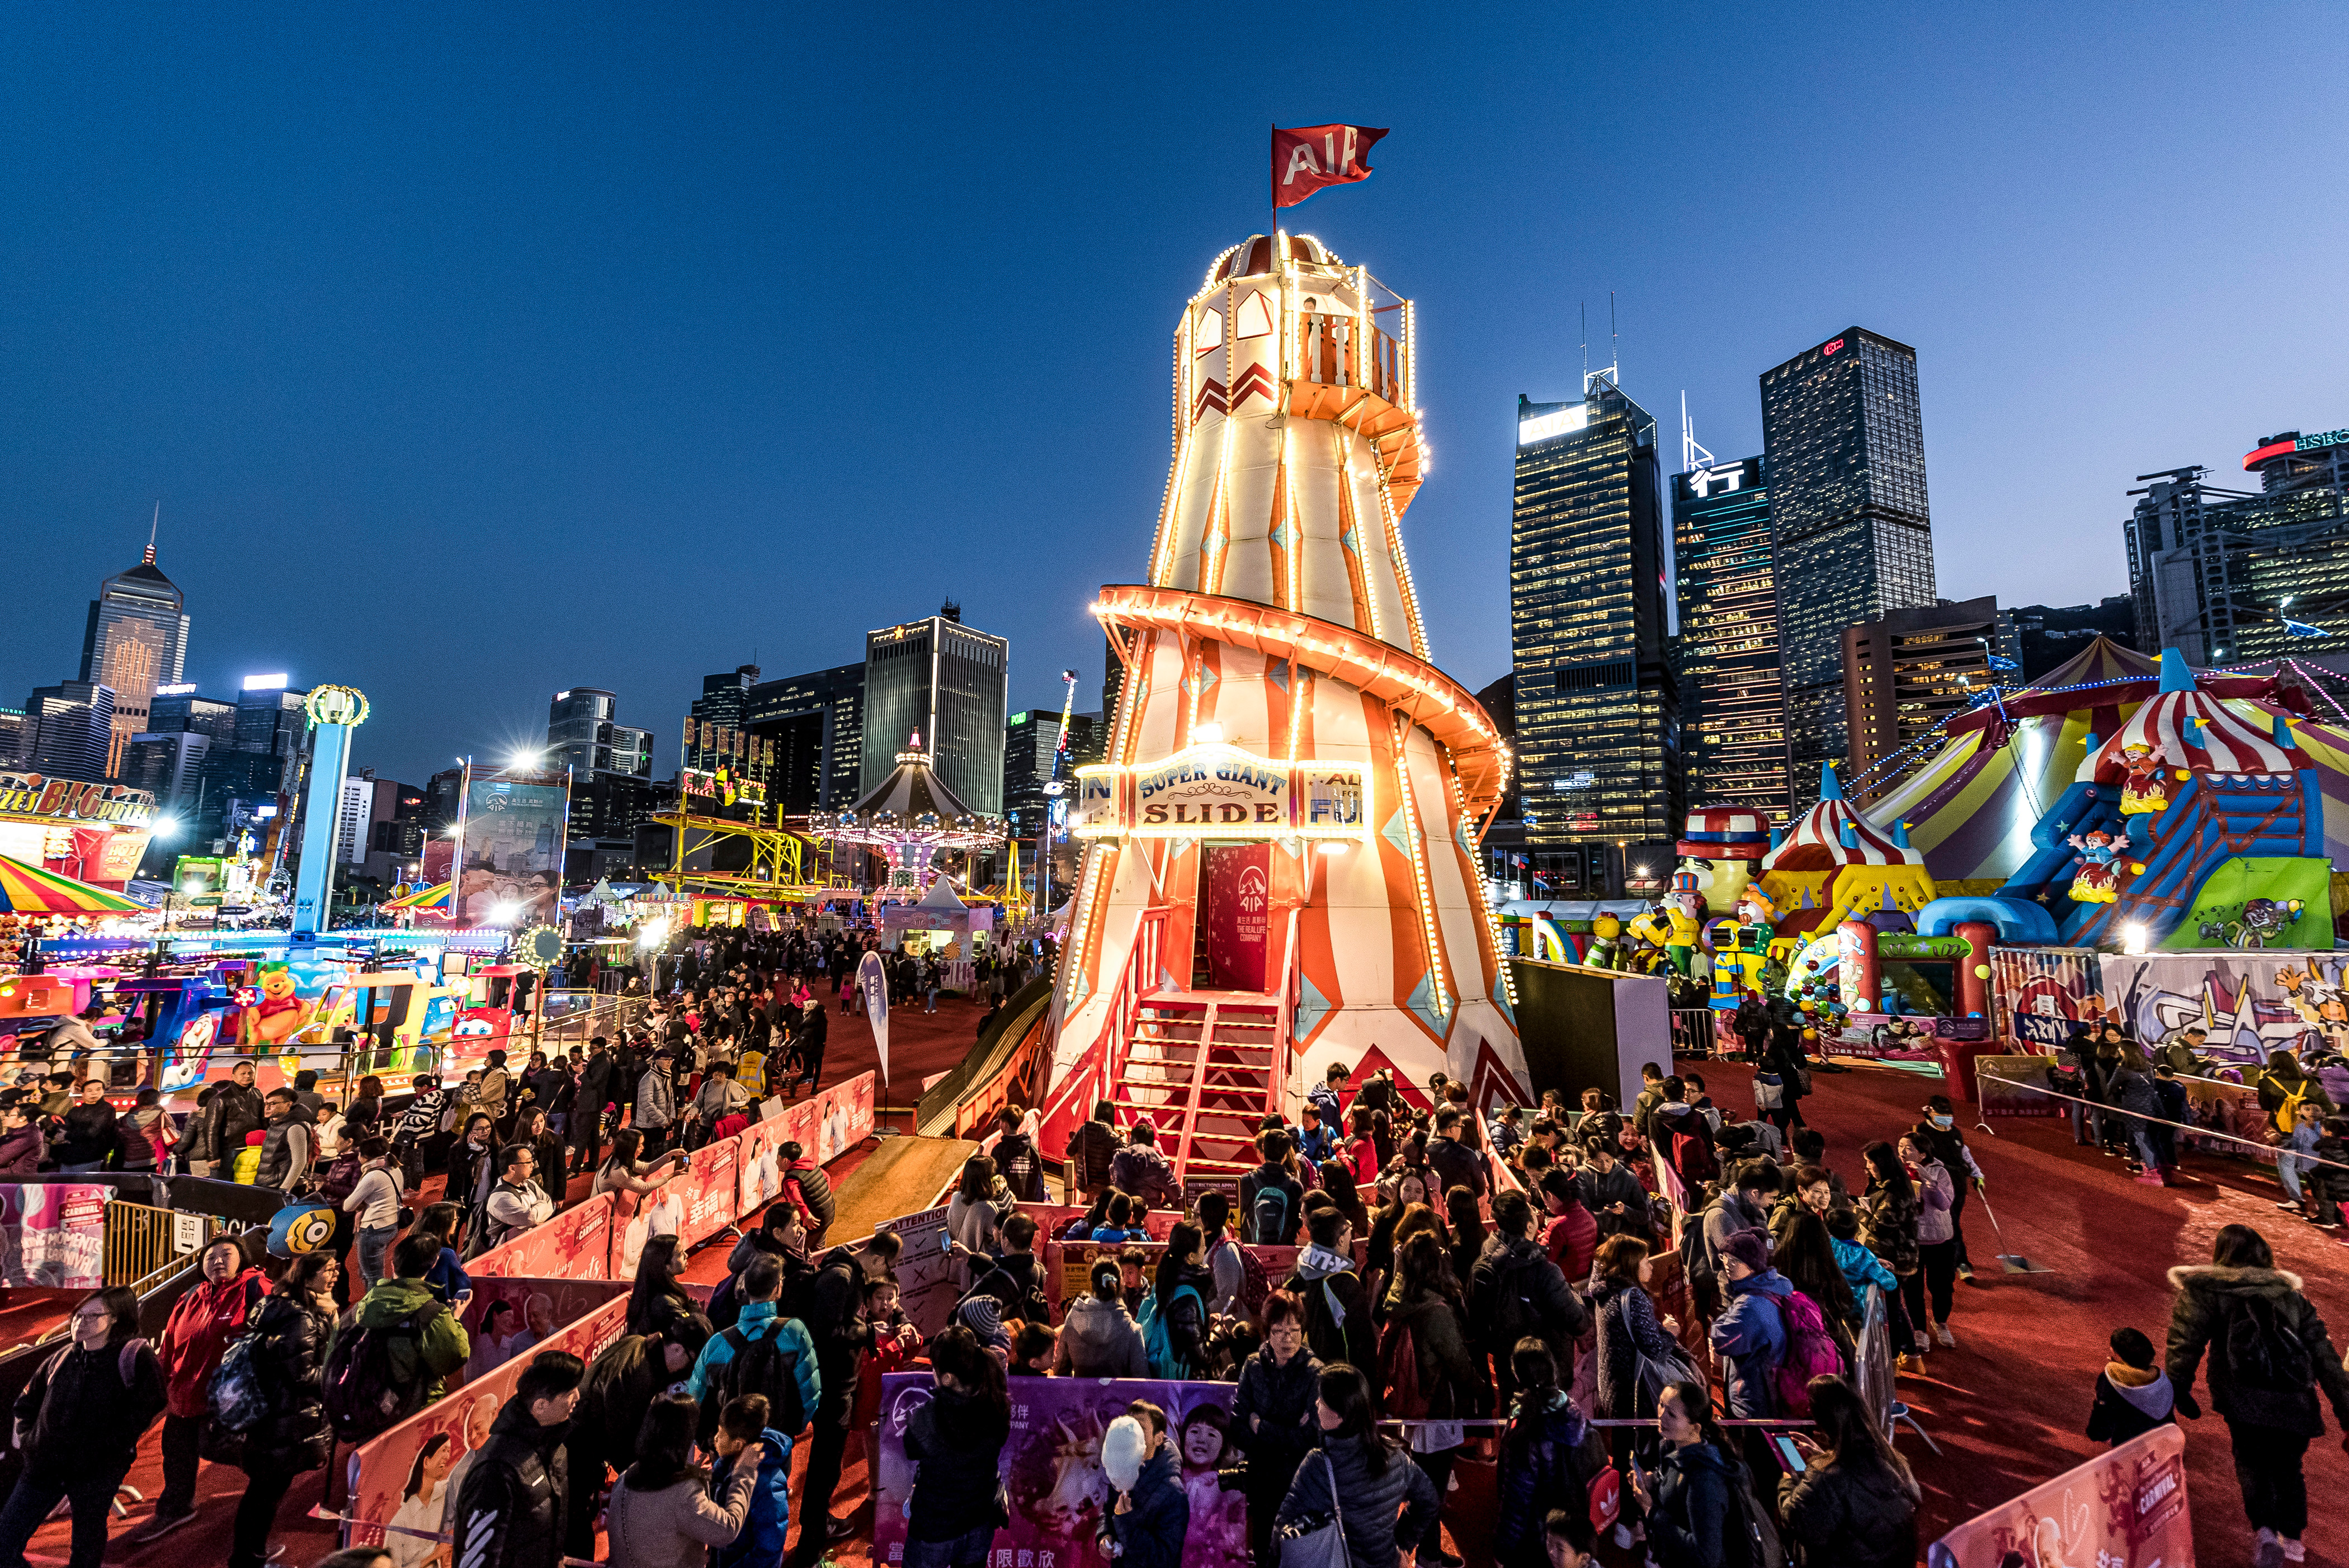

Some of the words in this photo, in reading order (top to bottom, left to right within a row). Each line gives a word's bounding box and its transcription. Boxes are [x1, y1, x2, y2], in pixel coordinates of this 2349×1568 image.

[1282, 125, 1357, 185] AIA
[1530, 413, 1576, 438] AIA
[1689, 461, 1744, 498] 行
[1139, 763, 1207, 800] SUPER
[1216, 762, 1287, 796] GIANT
[1325, 773, 1361, 786] AL
[0, 788, 39, 811] ZES
[35, 782, 103, 818] BIG
[1144, 802, 1279, 824] SLIDE
[108, 843, 144, 856] HOT
[1240, 896, 1263, 912] AIA
[689, 1189, 719, 1226] 幸福
[181, 1231, 195, 1240] EXIT
[578, 1215, 603, 1240] CARNIVAL
[1010, 1421, 1030, 1429] PANY
